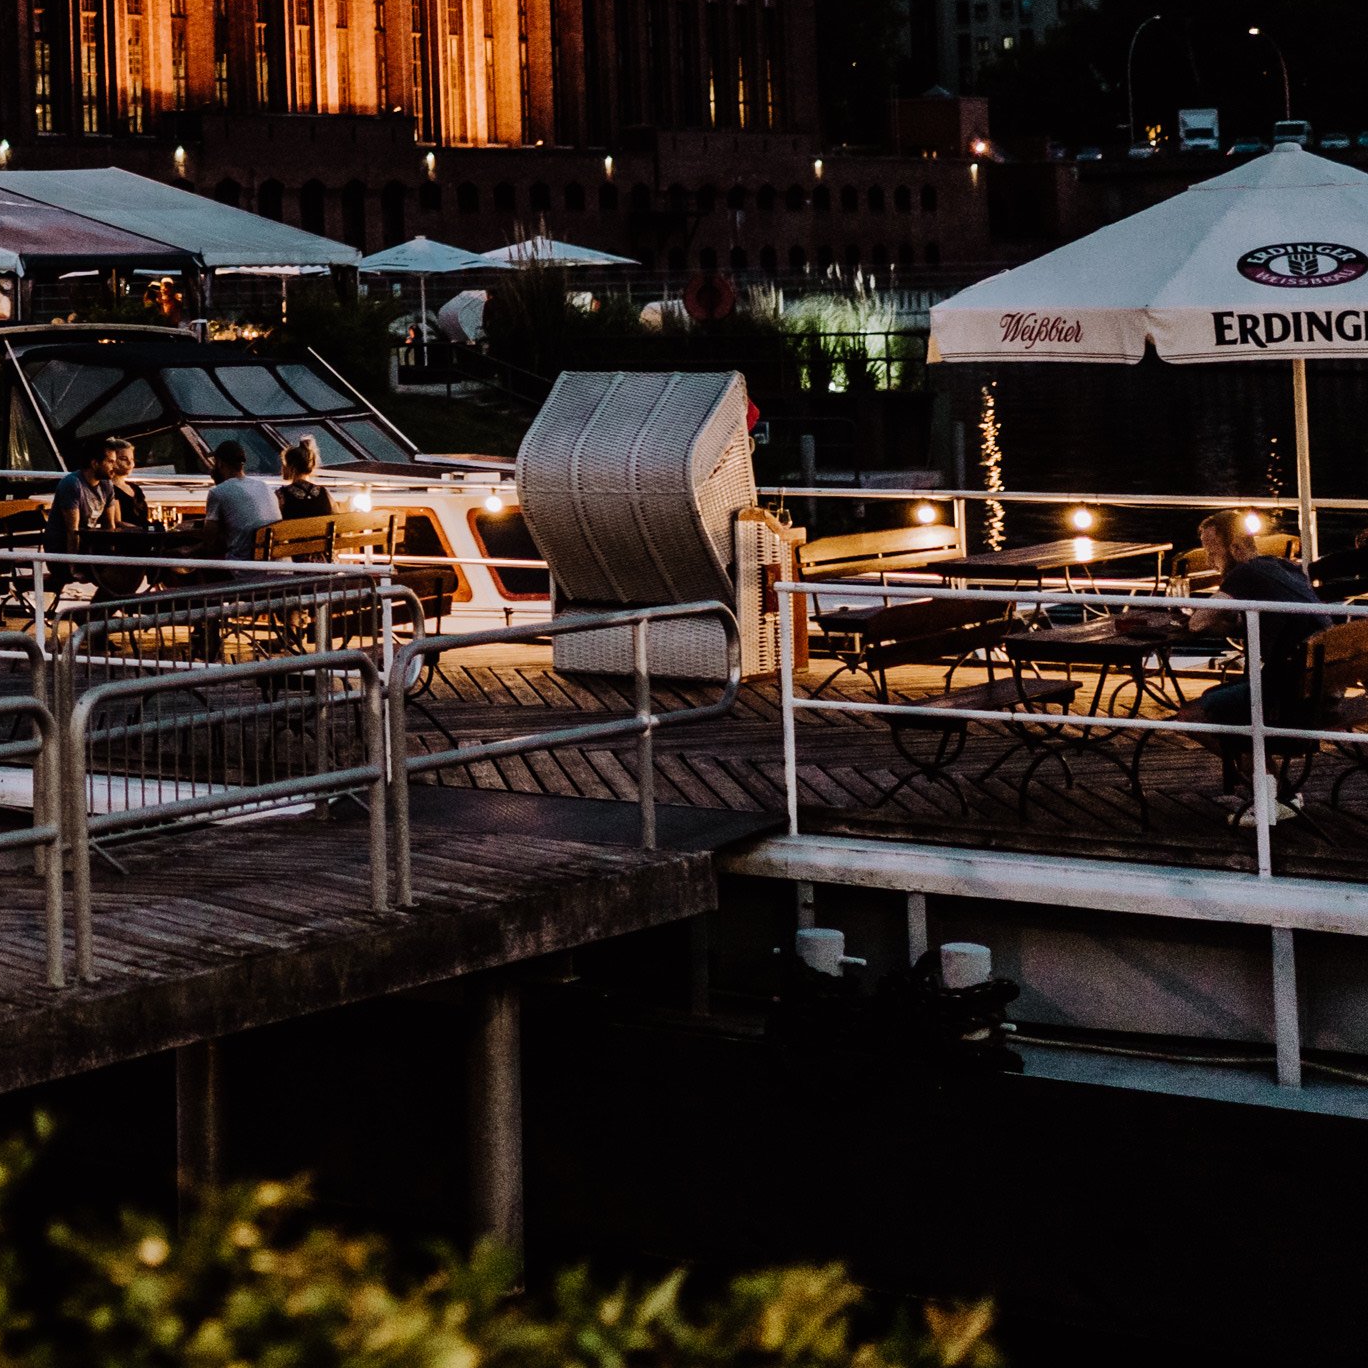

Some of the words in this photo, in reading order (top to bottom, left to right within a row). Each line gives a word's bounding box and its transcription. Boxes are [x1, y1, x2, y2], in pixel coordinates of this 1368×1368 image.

[1247, 244, 1357, 264] ERDINGER
[1000, 312, 1083, 349] Weißbier
[1211, 310, 1368, 348] ERDING
